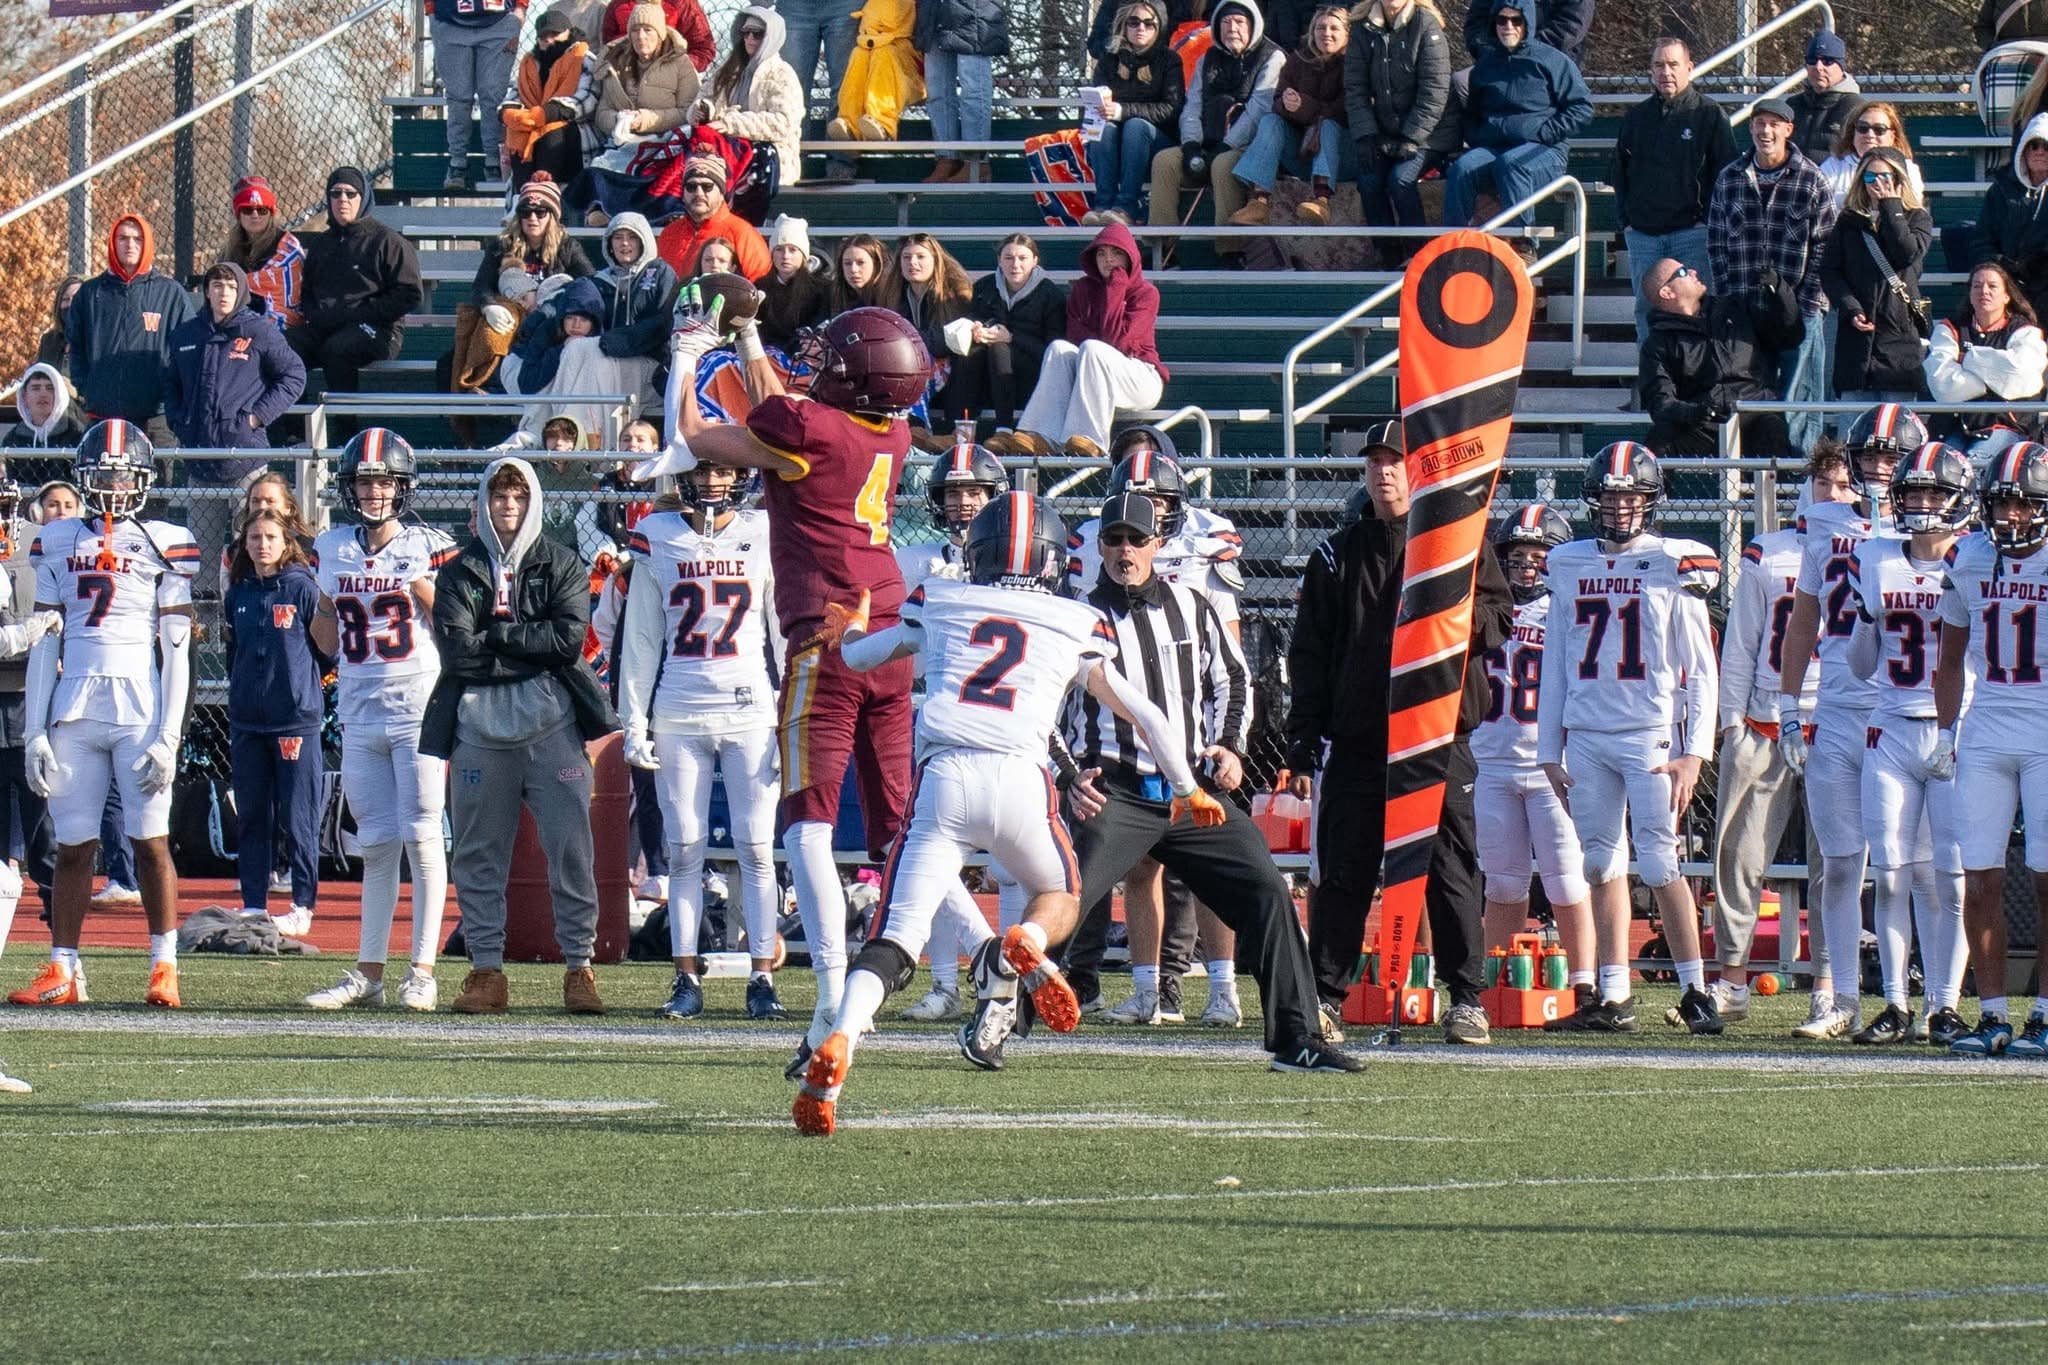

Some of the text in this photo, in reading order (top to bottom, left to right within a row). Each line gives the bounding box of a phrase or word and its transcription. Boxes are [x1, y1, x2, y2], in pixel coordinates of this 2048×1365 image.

[143, 311, 161, 332] W
[1421, 440, 1484, 475] PRO DOWN
[854, 453, 893, 545] 4
[677, 560, 745, 578] WALPOLE
[338, 577, 402, 593] WALPOLE
[1578, 578, 1641, 595] WALPOLE
[1825, 557, 1857, 636] 2
[1980, 581, 2048, 601] WALPOLE
[77, 573, 116, 627] 7
[1883, 592, 1941, 609] WALPO
[272, 604, 297, 629] W
[335, 591, 416, 664] 83
[669, 580, 752, 658] 27
[1511, 626, 1544, 645] POLE
[1574, 598, 1646, 680] 71
[1982, 601, 2041, 684] 11
[959, 615, 1029, 712] 2
[278, 736, 303, 760] W
[1866, 726, 1883, 749] W
[1390, 915, 1404, 973] PRO DOWN
[1405, 994, 1420, 1020] G
[1542, 995, 1558, 1021] G
[1295, 1048, 1320, 1067] N
